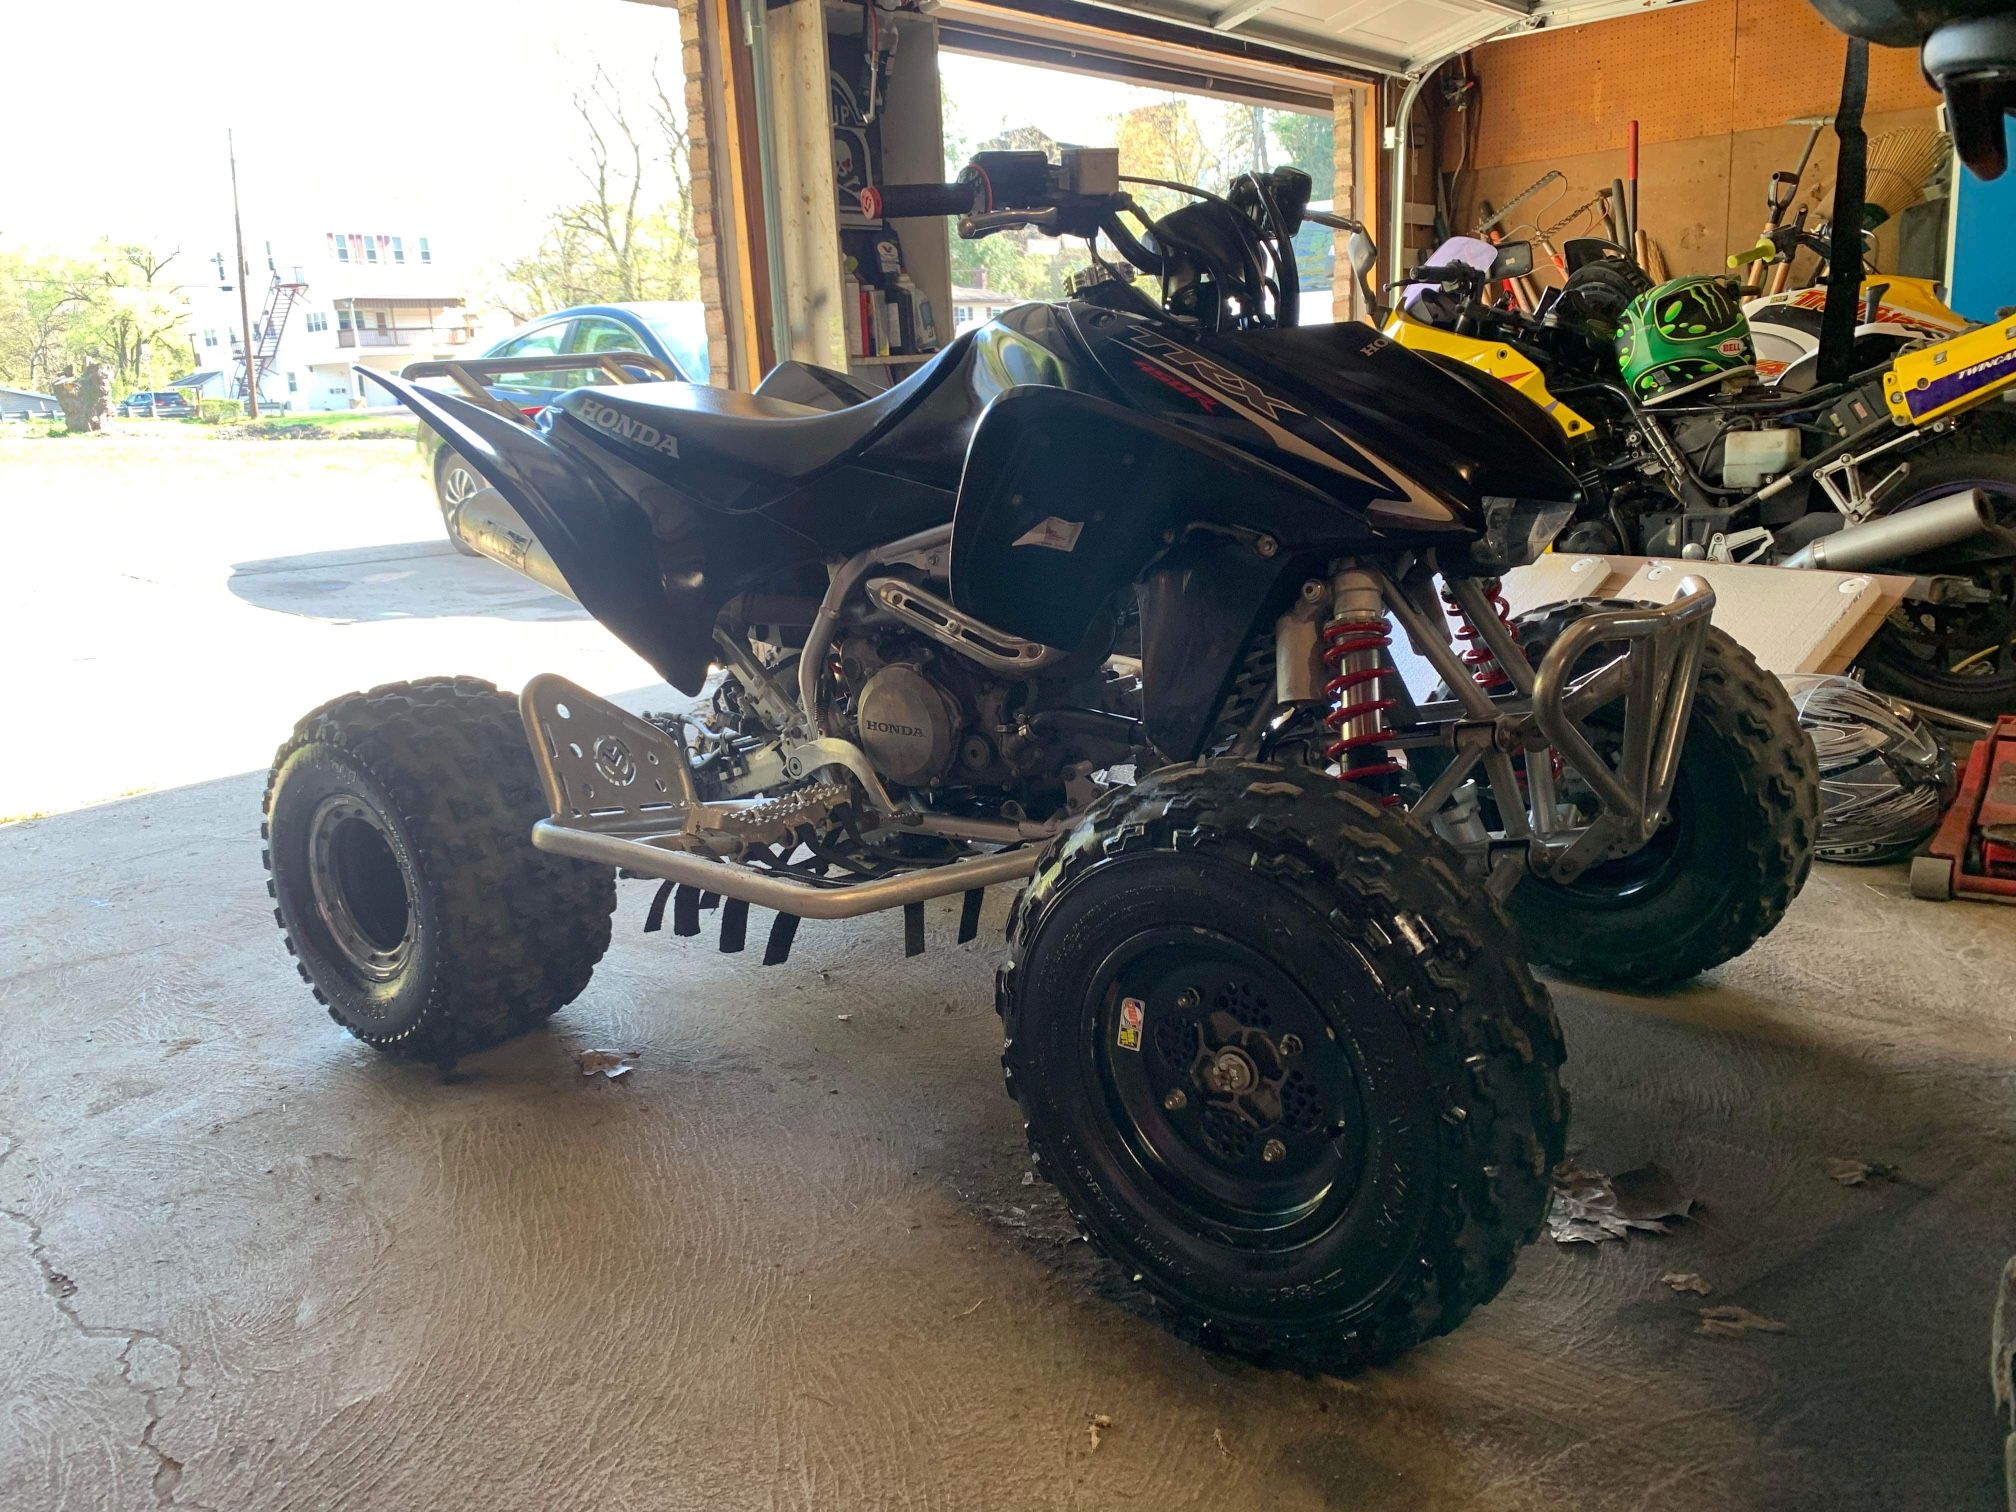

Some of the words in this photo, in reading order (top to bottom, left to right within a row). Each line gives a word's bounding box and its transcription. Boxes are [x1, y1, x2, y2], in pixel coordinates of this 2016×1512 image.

[1722, 342, 1741, 353] BELL
[1127, 325, 1308, 422] TRX
[580, 398, 680, 459] HONDA
[866, 720, 927, 738] HONDA
